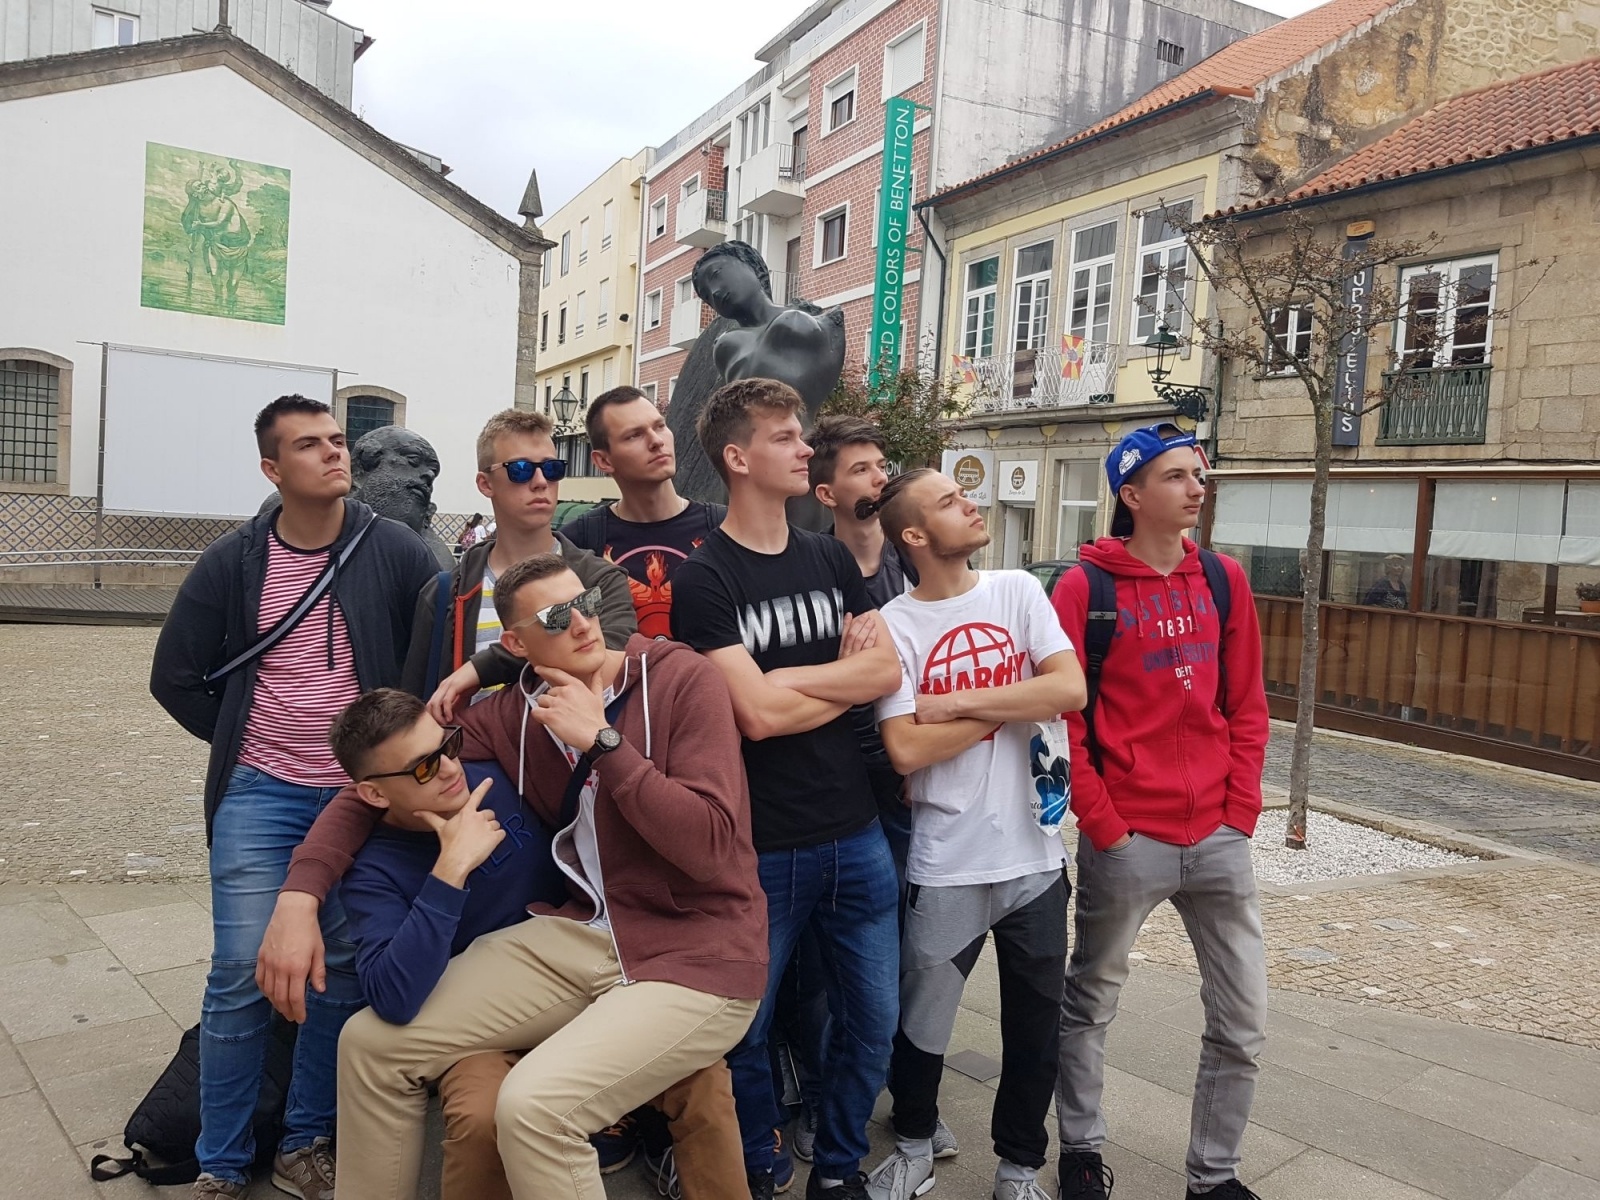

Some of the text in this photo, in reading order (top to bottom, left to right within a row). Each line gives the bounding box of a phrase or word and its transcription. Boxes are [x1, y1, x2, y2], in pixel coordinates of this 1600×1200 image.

[888, 217, 902, 243] OF
[882, 248, 900, 325] COLORS
[1157, 615, 1193, 638] 1831
